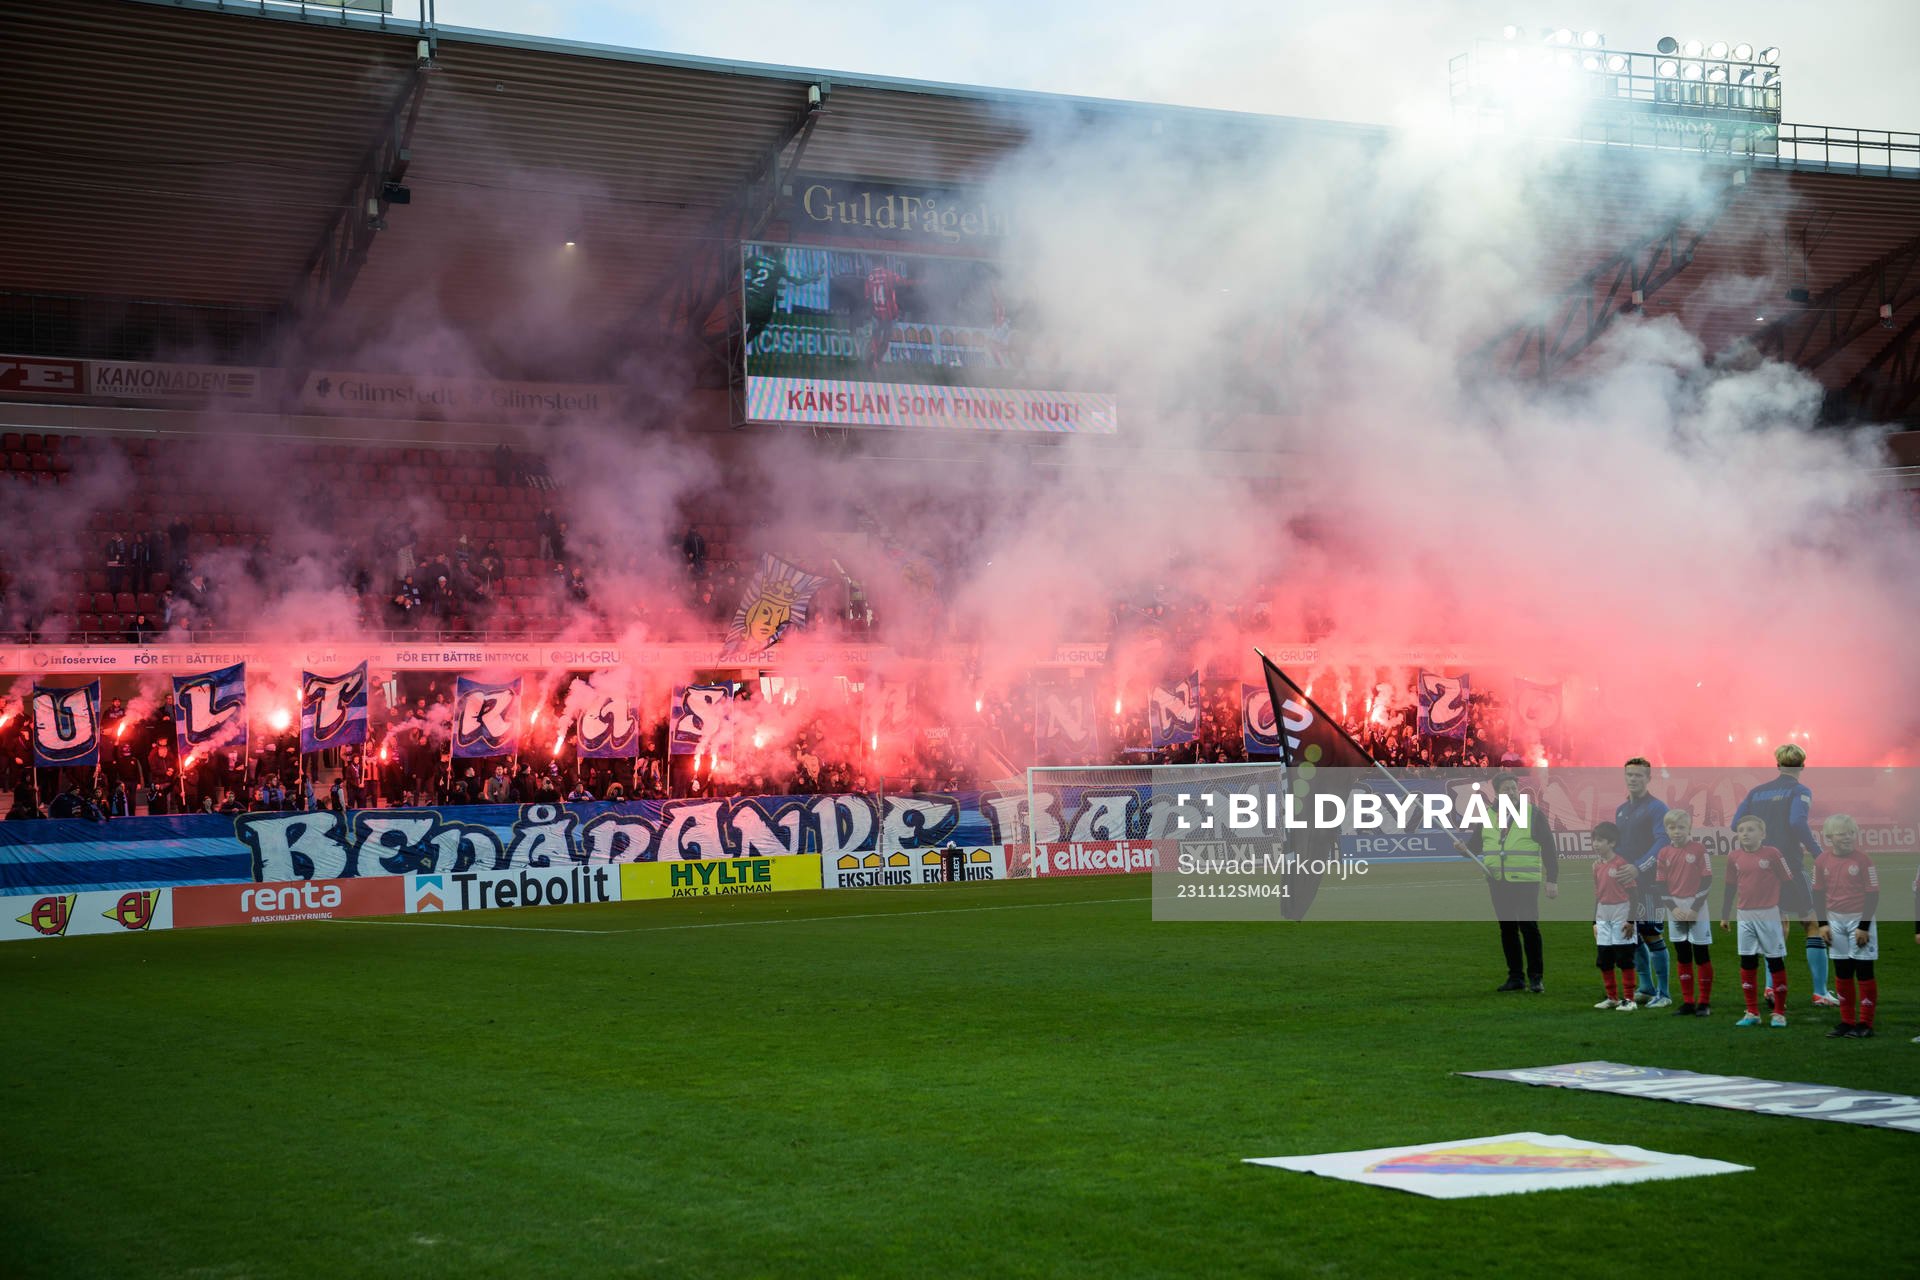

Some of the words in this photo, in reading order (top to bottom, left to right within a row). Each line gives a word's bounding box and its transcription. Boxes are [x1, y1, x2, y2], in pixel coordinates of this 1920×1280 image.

[97, 366, 225, 391] KANONADEN
[788, 386, 890, 415] KÄNSLAN
[899, 396, 945, 417] SOM
[953, 399, 1016, 421] FINNS
[51, 655, 117, 665] infoservice
[134, 651, 158, 665] FÖR
[186, 651, 229, 665] BÄTTRE
[397, 651, 418, 662] FÖR
[421, 653, 439, 662] ETT
[443, 650, 482, 662] BÄTTRE
[485, 653, 529, 662] INTRYCK
[1858, 824, 1916, 847] renta
[1054, 842, 1161, 872] elkedjan
[241, 881, 342, 913] renta
[452, 866, 609, 911] Trebolit
[672, 887, 698, 899] JAKT
[703, 885, 711, 896] &
[716, 884, 772, 896] LANTMAN
[251, 911, 333, 923] MASKINUTHYRNING
